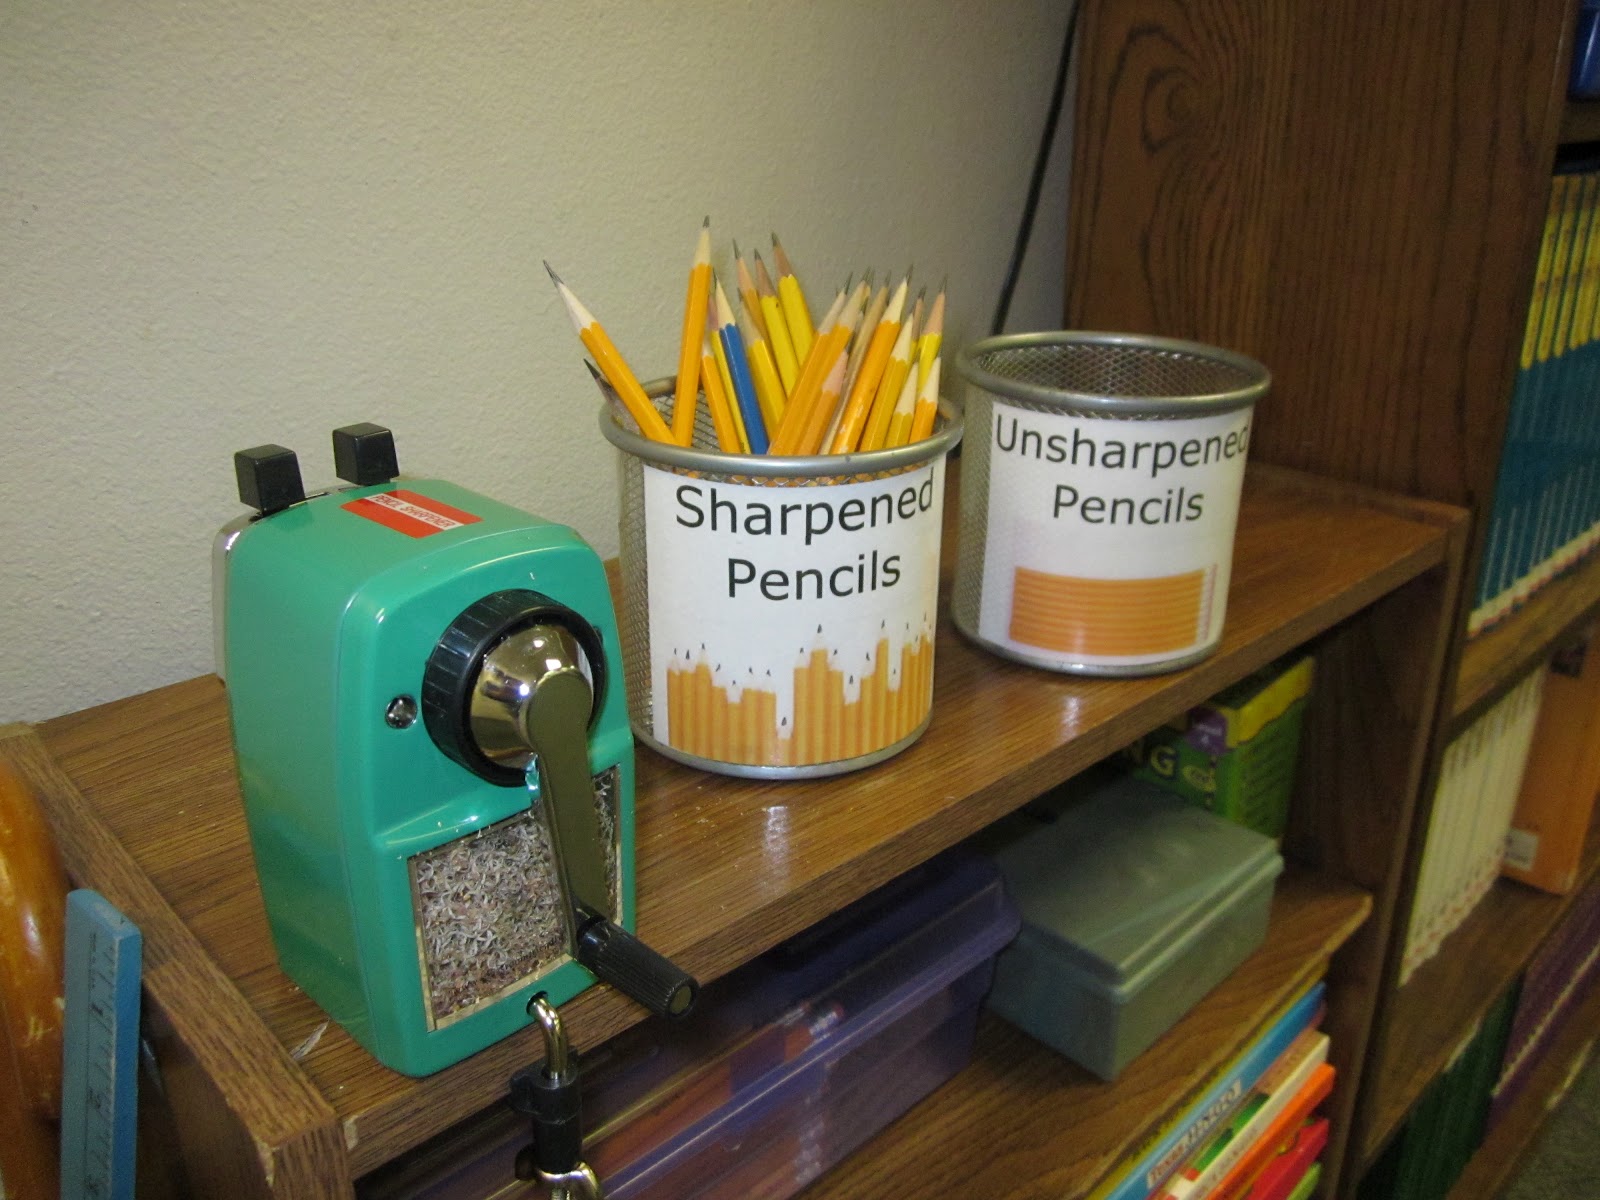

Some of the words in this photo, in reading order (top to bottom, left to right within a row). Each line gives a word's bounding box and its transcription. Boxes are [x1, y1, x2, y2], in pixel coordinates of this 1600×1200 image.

[400, 506, 457, 528] SHARPENER
[675, 467, 935, 546] Sharpened
[1053, 484, 1205, 526] Pencils
[727, 549, 902, 601] Pencils
